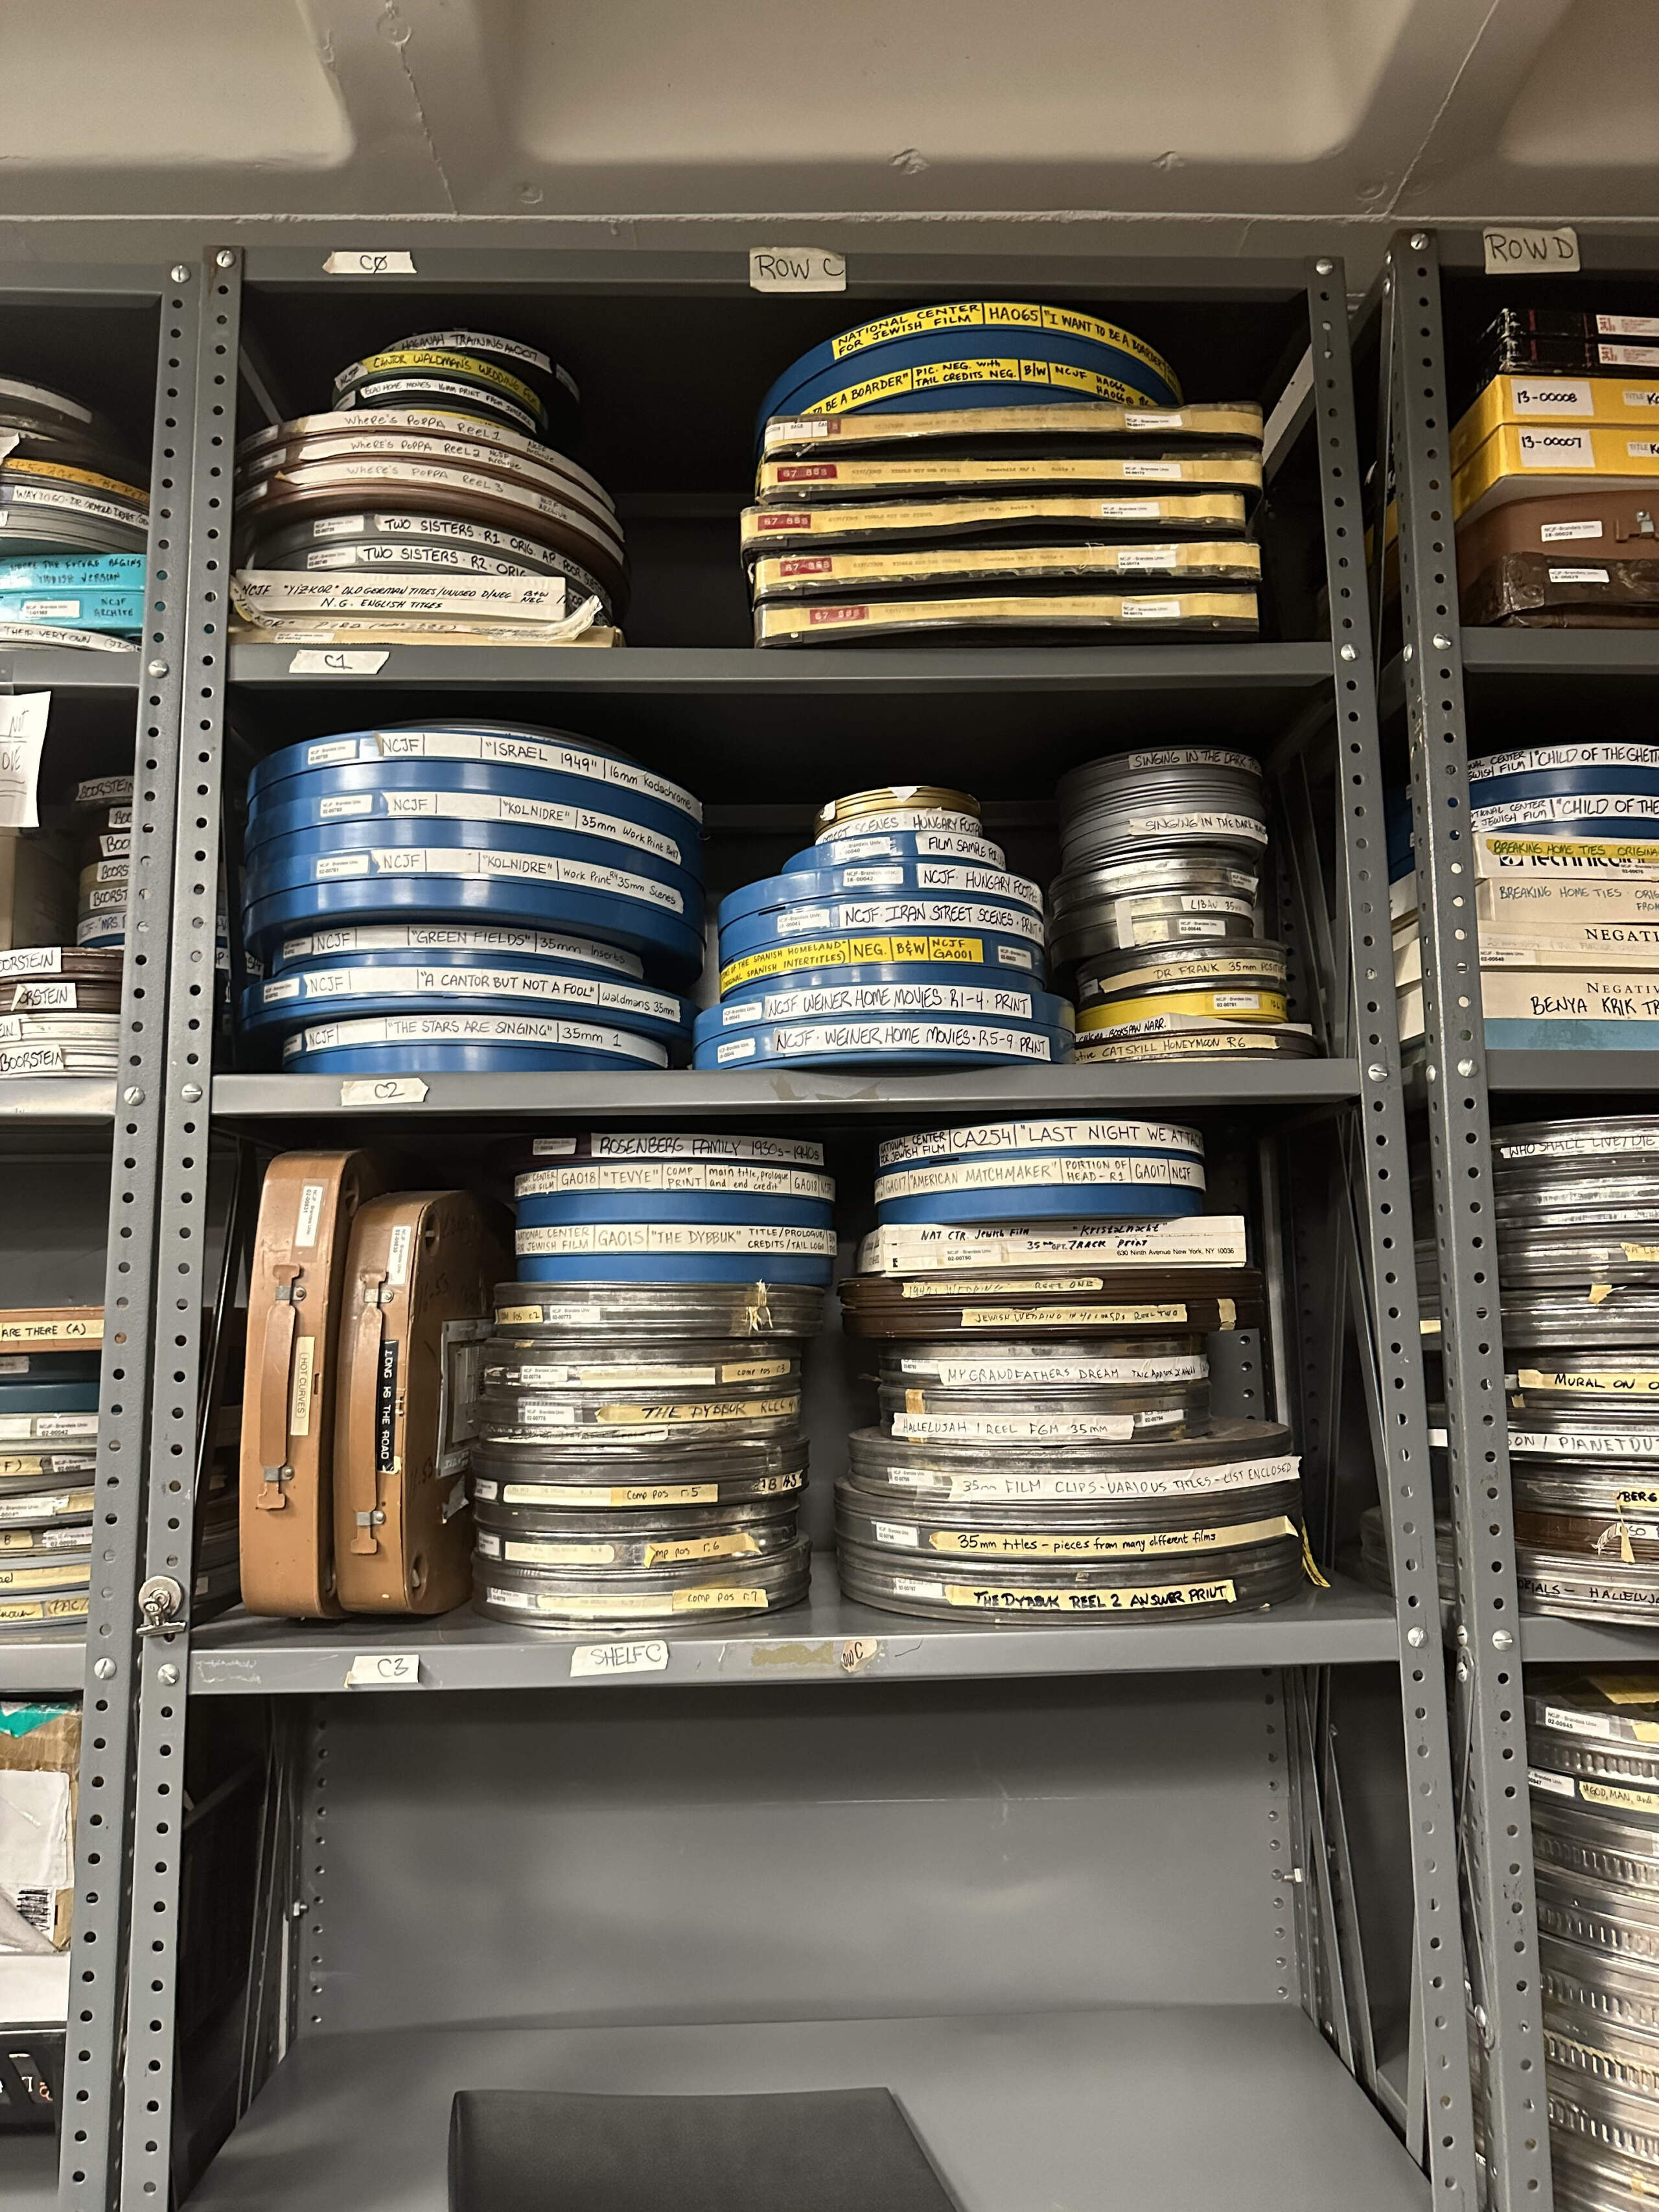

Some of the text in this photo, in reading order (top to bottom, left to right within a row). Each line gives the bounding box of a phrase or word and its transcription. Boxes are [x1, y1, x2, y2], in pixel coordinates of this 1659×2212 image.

[1485, 233, 1573, 261] ROW D
[754, 254, 844, 279] ROW C
[989, 309, 1038, 322] HA065
[1060, 314, 1093, 332] WANT
[838, 305, 979, 345] NATIONAL CENTER
[839, 314, 971, 356] FOR JEWISH FILM
[374, 353, 518, 389] CANTOR WALDMAN'S WEDDING
[943, 371, 982, 382] CREDITS
[1516, 392, 1577, 403] 13-00008
[1522, 436, 1581, 448] 13-00007
[384, 520, 473, 537] TWO SISTERS
[364, 548, 458, 563] TWO SISTERS
[361, 599, 405, 609] ENGLISH
[325, 655, 353, 669] C1
[383, 739, 419, 754] NCJF
[1582, 747, 1625, 759] OF THE
[1133, 752, 1220, 767] SINGING THE
[1491, 752, 1525, 765] CENTER
[1500, 762, 1525, 773] FILM
[610, 766, 691, 810] 16mm Kodachrome
[393, 799, 426, 812] NCJF
[1510, 800, 1545, 811] CENTER
[1615, 800, 1636, 813] OF
[582, 814, 616, 834] 35mm
[1145, 817, 1233, 830] SINGING THE
[1481, 809, 1546, 826] JEWISH FILM
[929, 837, 986, 856] FILM SAMPLE
[1494, 841, 1606, 855] BREAKING HOME TIES
[383, 855, 419, 868] NCJF
[563, 868, 586, 881] Work
[923, 868, 1012, 889] NCJF HUNGARY
[1500, 886, 1621, 899] BREAKING HOME TIES
[846, 905, 972, 924] NCJF IRAN STREET
[318, 933, 350, 949] NCJF
[540, 937, 625, 964] 35mm Inserts
[853, 943, 887, 957] NEG.
[782, 950, 846, 969] INTERTITLES)
[1179, 962, 1256, 975] FRANK 35mm
[309, 977, 343, 994] NCJF
[441, 973, 548, 994] CANTOR BUT NOT
[804, 990, 1028, 1011] WEINER HOME MOVIES PRINT
[1531, 997, 1636, 1015] BENYA KRIK
[422, 1019, 490, 1033] STARS ARE
[309, 1030, 334, 1047] NCJF
[563, 1027, 602, 1042] 35mm
[776, 1029, 1045, 1053] NCJF WEINER HOME MOVIES PRINT
[1102, 1038, 1219, 1058] CATSKILL HONEYMOON
[1, 1050, 63, 1072] BOORSTEIN
[375, 1082, 404, 1099] C2
[911, 1131, 946, 1143] CENTER
[953, 1130, 1010, 1148] CA254
[1089, 1126, 1167, 1141] NIGHT WE
[601, 1137, 741, 1156] ROSENBERG FAMILY
[923, 1143, 944, 1154] FILM
[1509, 1145, 1535, 1158] WHO
[667, 1167, 693, 1176] COMP
[1065, 1160, 1111, 1169] PORTION
[604, 1169, 659, 1184] "TEVYE"
[709, 1167, 788, 1182] main prologue
[668, 1178, 702, 1187] PRINT
[710, 1178, 726, 1188] and
[548, 1228, 590, 1237] CENTER
[25, 1325, 58, 1336] THERE
[67, 1324, 86, 1334] (A)
[1078, 1368, 1119, 1380] DREAM
[1555, 1373, 1635, 1389] MURAL ON
[297, 1377, 306, 1414] CURVES
[380, 1349, 392, 1460] LONG IS THE ROAD
[642, 1406, 681, 1419] THE
[986, 1423, 1108, 1434] REEL 35mm
[963, 1464, 1292, 1493] 35mm FILM TITLES ENCLOSED
[652, 1489, 669, 1499] pos
[958, 1531, 1216, 1553] 35mm titles pieces from many different films
[676, 1546, 690, 1556] pos
[718, 1594, 734, 1602] pos
[974, 1587, 1224, 1607] THE REEL ANSWER PRINT
[592, 1645, 660, 1667] SHELF C
[377, 1659, 406, 1677] C3
[1636, 1795, 1652, 1804] and
